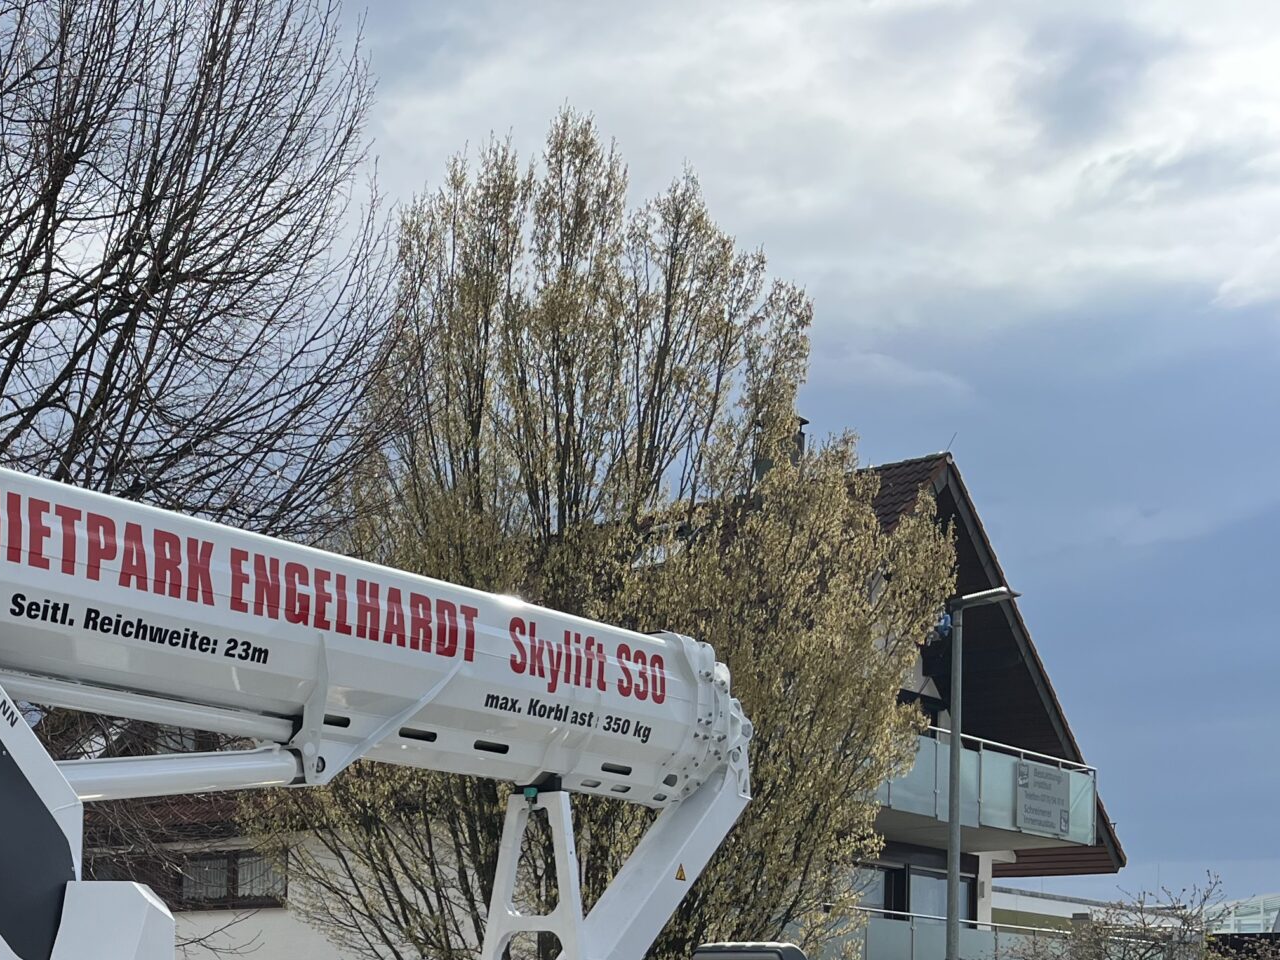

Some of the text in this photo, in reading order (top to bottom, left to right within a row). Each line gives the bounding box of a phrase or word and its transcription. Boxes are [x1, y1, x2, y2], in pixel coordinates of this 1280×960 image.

[9, 593, 269, 664] Seitl. Reichweite: 23m
[229, 547, 478, 662] ENGELHARDT
[509, 616, 607, 693] Skylift
[617, 643, 666, 704] S30
[484, 693, 522, 713] max.
[603, 715, 631, 735] 350
[633, 721, 652, 744] kg
